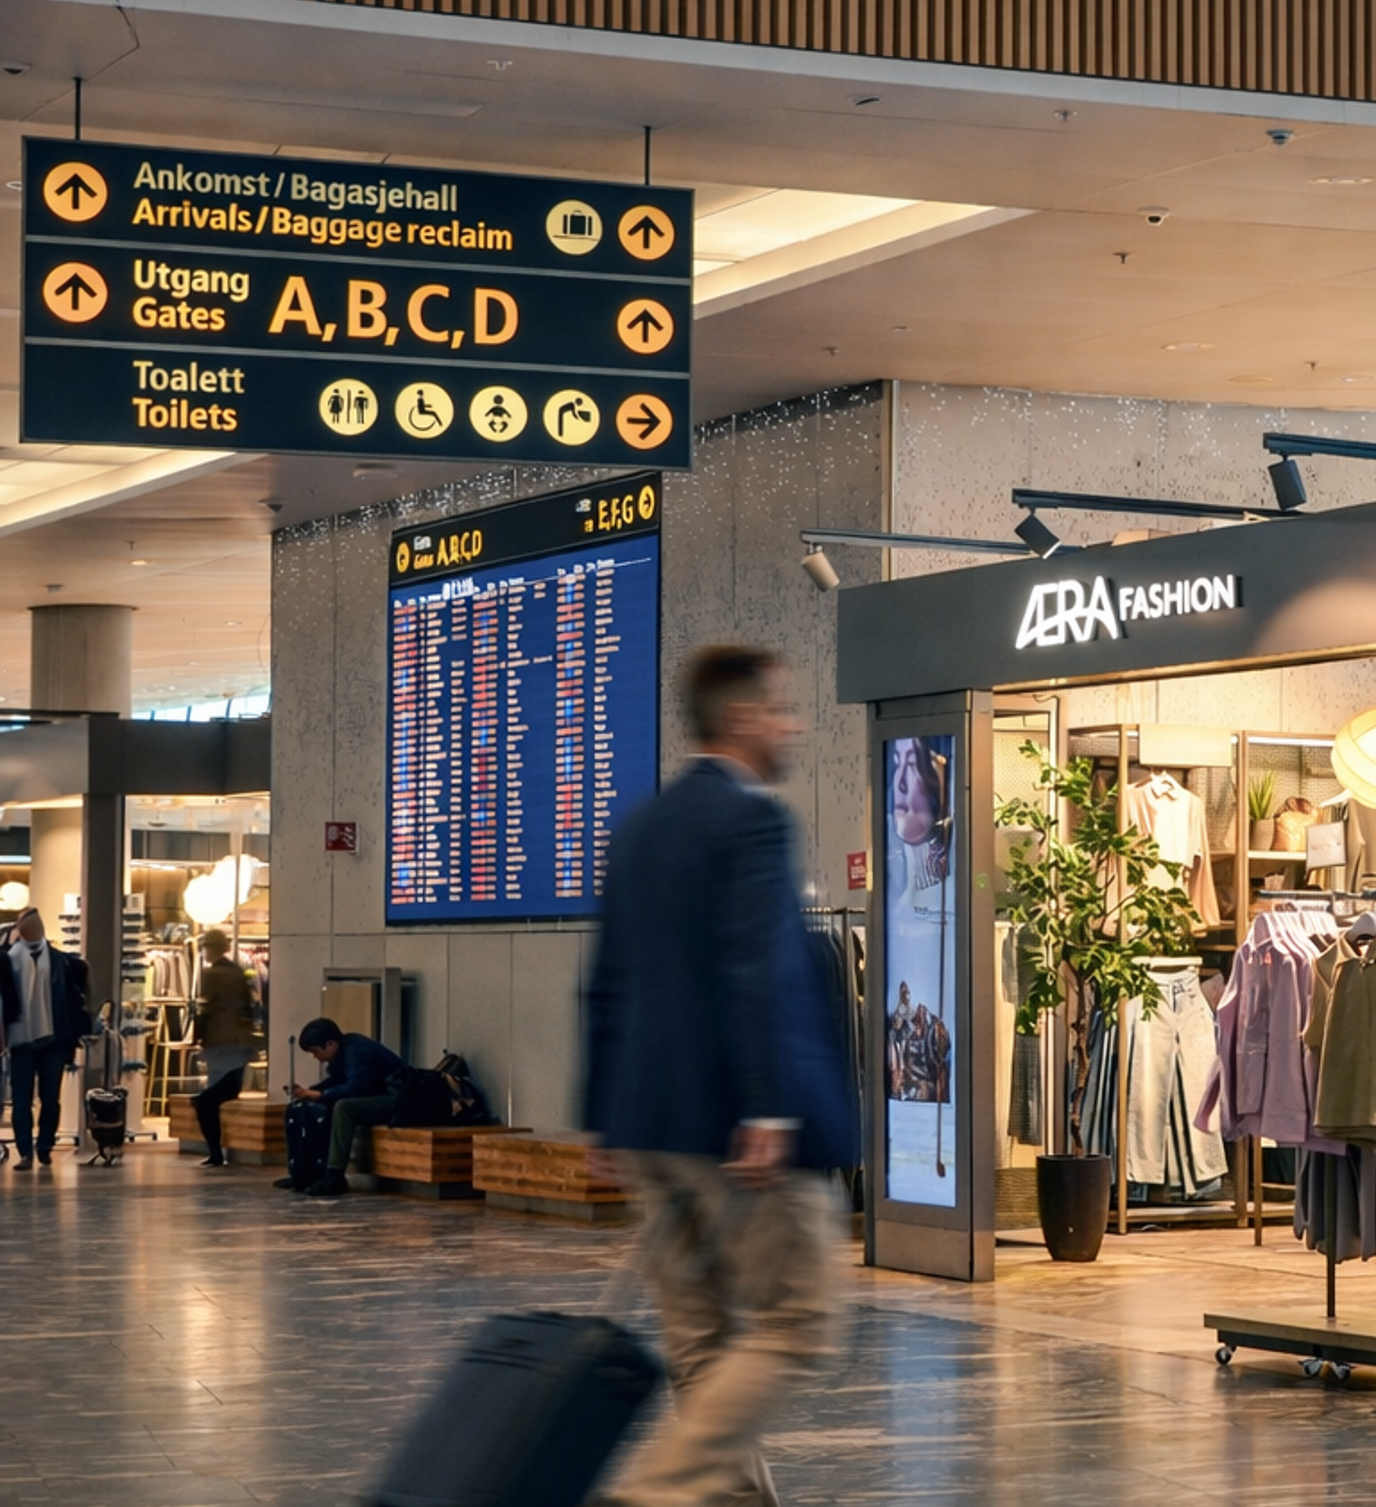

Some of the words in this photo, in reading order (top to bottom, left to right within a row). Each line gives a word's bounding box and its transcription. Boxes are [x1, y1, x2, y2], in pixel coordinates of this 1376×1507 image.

[407, 219, 513, 250] reclaim
[134, 259, 250, 302] Utgang
[132, 296, 226, 331] Gates
[132, 360, 245, 394] Toalett
[132, 397, 238, 432] Toilets
[1119, 574, 1235, 622] FASHION
